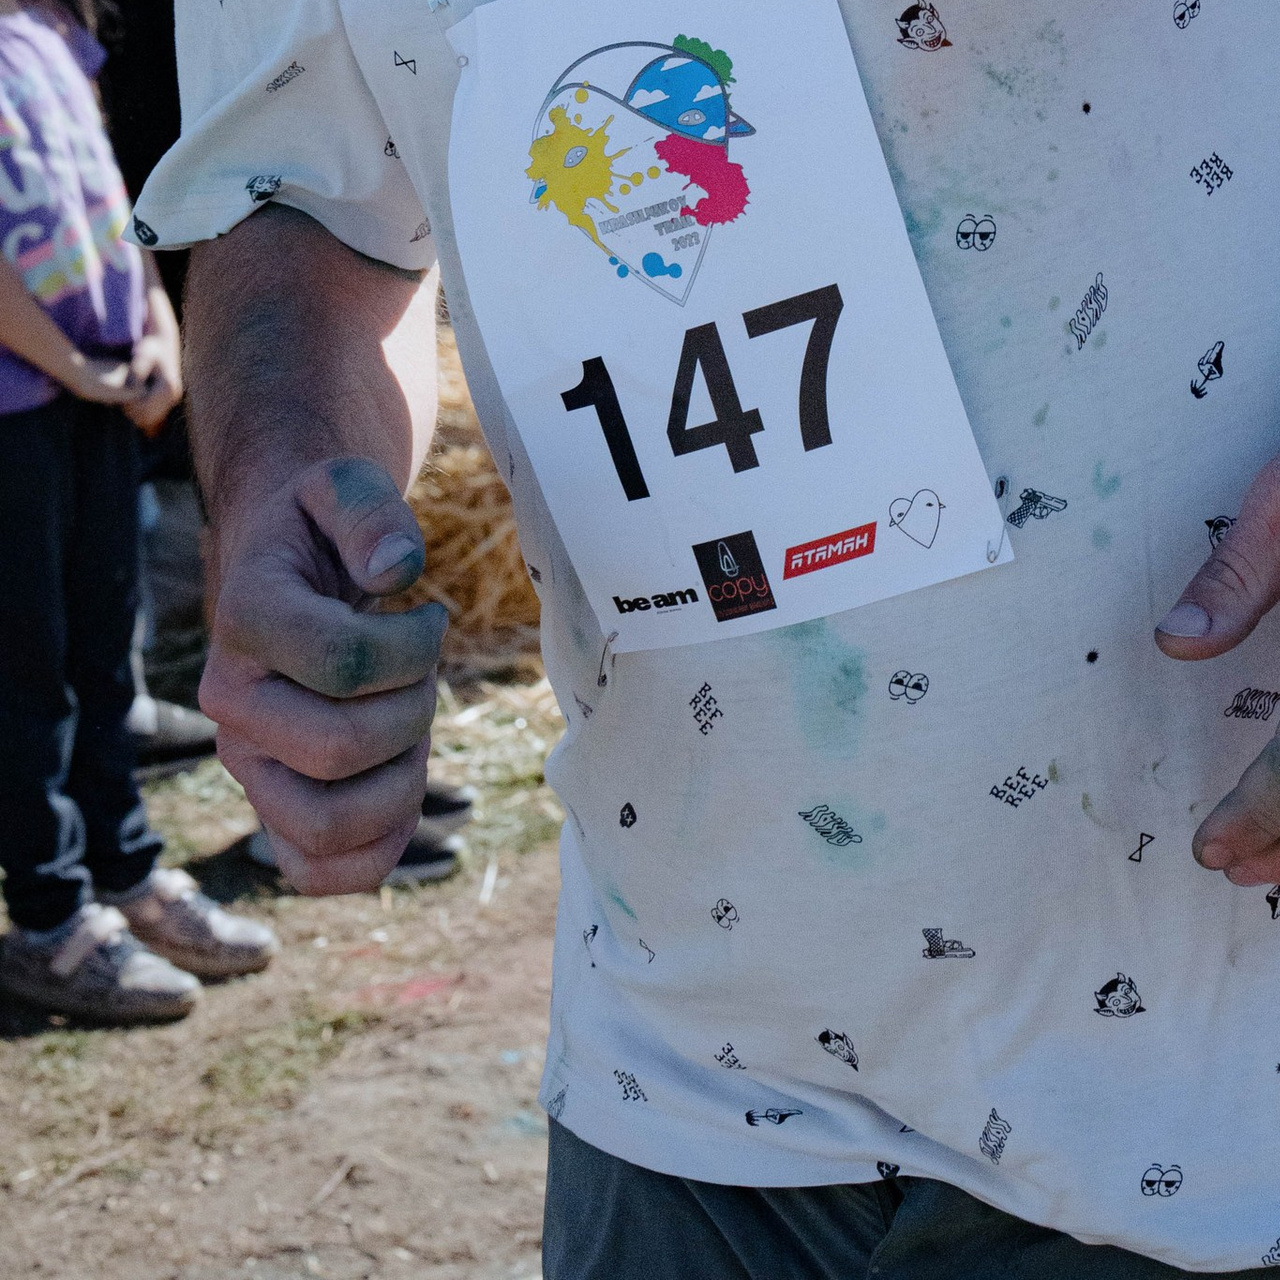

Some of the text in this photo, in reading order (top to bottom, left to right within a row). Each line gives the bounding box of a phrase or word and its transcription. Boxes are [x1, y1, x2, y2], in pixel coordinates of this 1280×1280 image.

[1189, 152, 1224, 185] REE
[1203, 165, 1235, 197] BEF
[598, 195, 686, 235] KRASILNIKOV
[654, 215, 695, 236] TRAIL
[560, 283, 844, 502] 147
[709, 574, 769, 602] copy
[689, 695, 714, 736] REE
[698, 682, 724, 721] BEF
[989, 766, 1032, 800] BEF
[1004, 774, 1050, 808] REE
